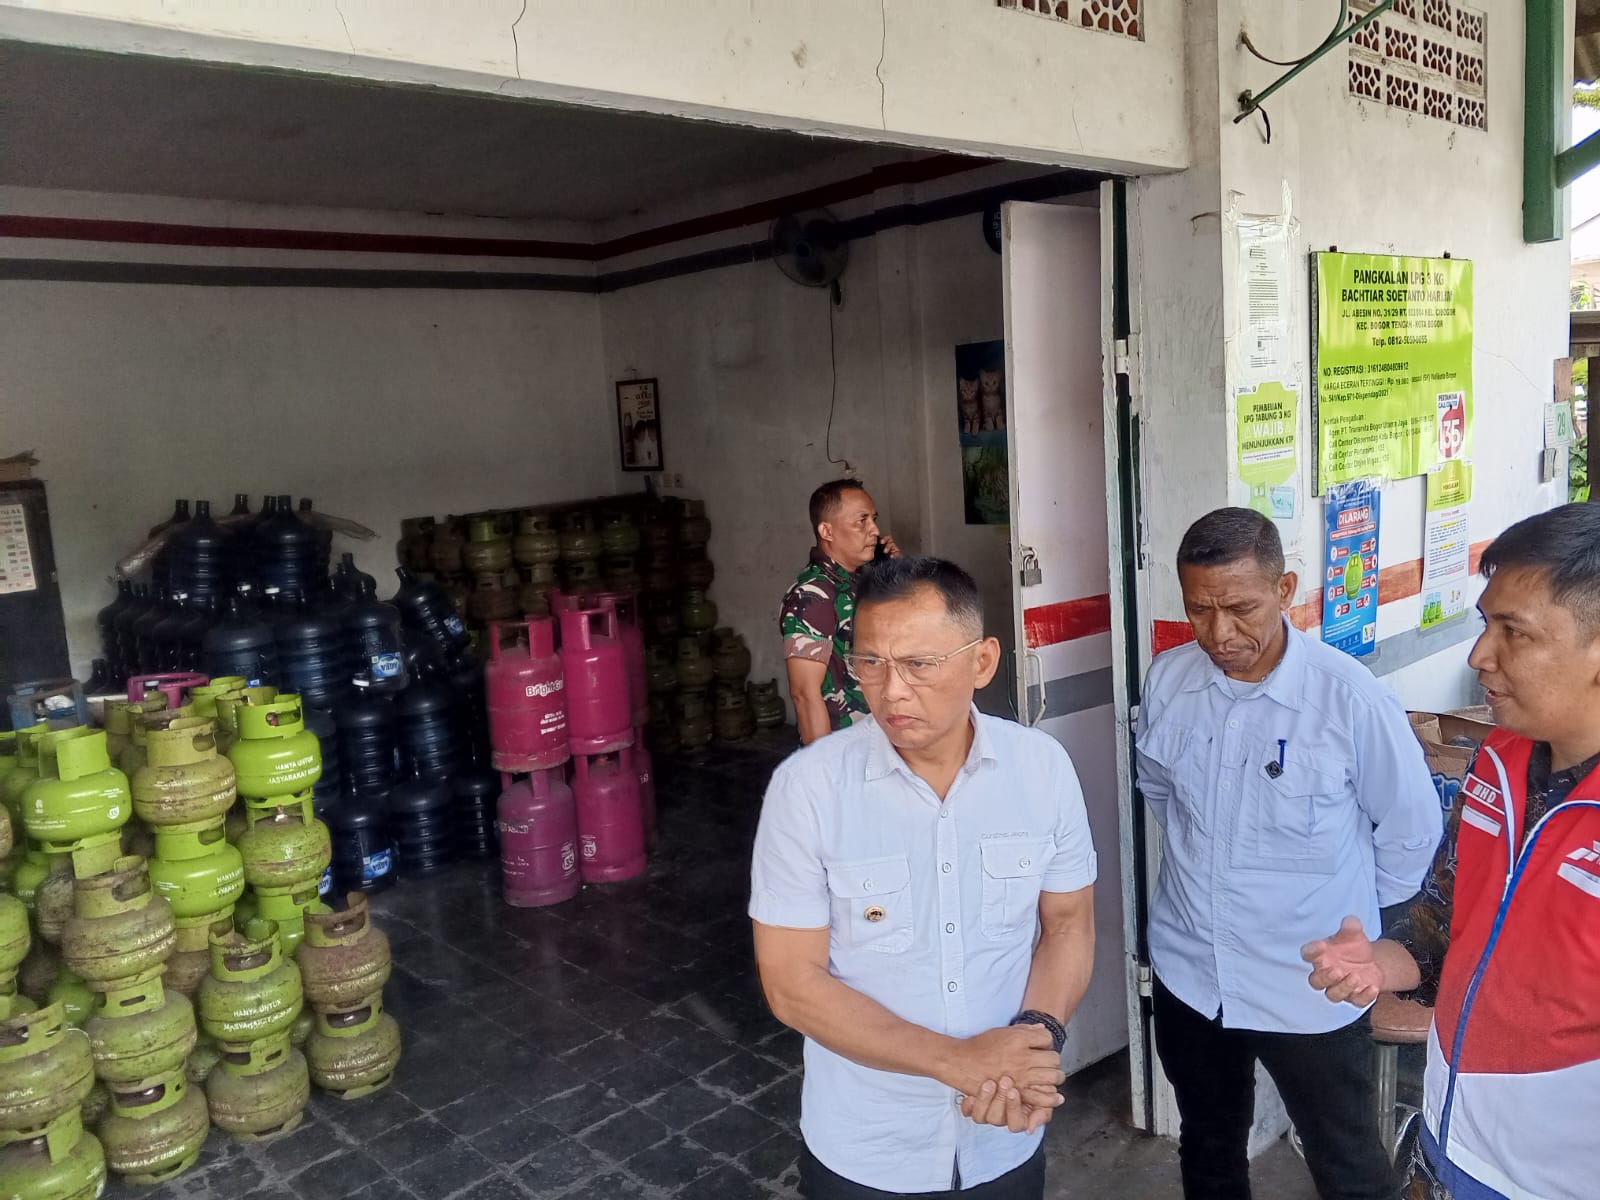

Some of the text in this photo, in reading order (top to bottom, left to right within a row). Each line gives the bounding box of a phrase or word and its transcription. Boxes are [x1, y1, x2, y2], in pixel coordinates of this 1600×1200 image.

[1353, 270, 1408, 285] PANGKALAN
[1410, 271, 1424, 285] LPG
[1434, 272, 1444, 286] KG
[1342, 289, 1383, 302] BACHTIAR
[1386, 290, 1425, 302] SOETANTO
[1342, 309, 1351, 318] JL.
[1372, 309, 1382, 317] NO.
[1356, 321, 1370, 330] KEC.
[1370, 320, 1391, 329] BOGOR
[1391, 320, 1412, 329] TENGAH
[1333, 365, 1363, 376] REGISTRASI
[1253, 402, 1283, 413] PEMBELIAN
[1243, 410, 1291, 423] LPG TABUNG 3 KG
[1253, 423, 1284, 438] WAJIB
[1242, 435, 1294, 449] MENUNJUKKAN KTP
[1329, 440, 1338, 448] Call
[1338, 438, 1353, 447] Center
[1329, 452, 1338, 460] Call
[1339, 509, 1369, 525] DILARANG
[275, 761, 297, 770] HANYA
[257, 998, 282, 1013] UNTUK
